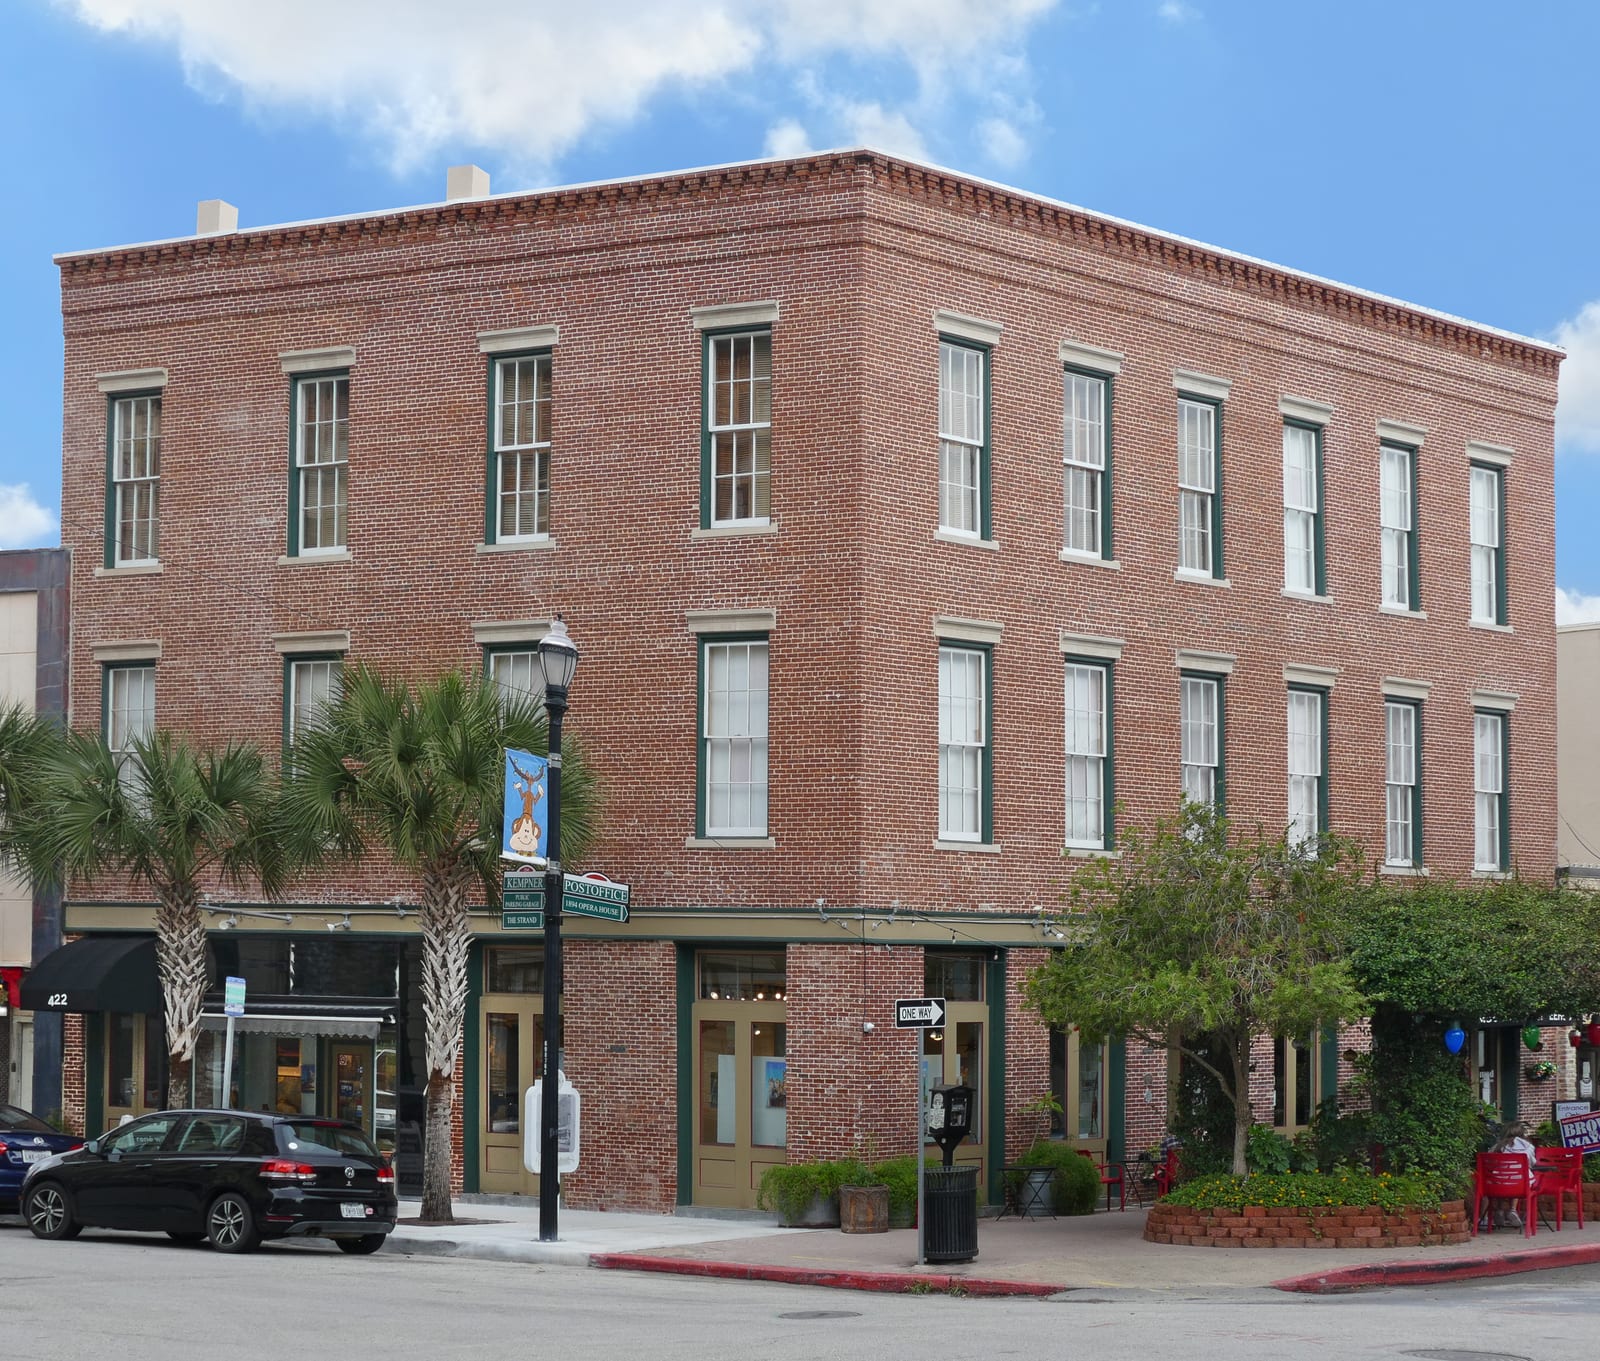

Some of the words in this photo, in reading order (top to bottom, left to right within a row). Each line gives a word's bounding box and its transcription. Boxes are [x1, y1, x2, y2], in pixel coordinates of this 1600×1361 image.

[506, 877, 543, 889] KEMPNER
[564, 880, 628, 901] POSTOFFICE
[565, 900, 578, 909] 1894
[578, 902, 598, 913] OPERA
[598, 906, 619, 916] HOUSE
[507, 916, 517, 924] THE
[517, 916, 537, 924] STRAND
[48, 993, 68, 1007] 422
[901, 1008, 916, 1020] ONE
[918, 1007, 932, 1019] WAY
[1568, 1134, 1600, 1148] MAY
